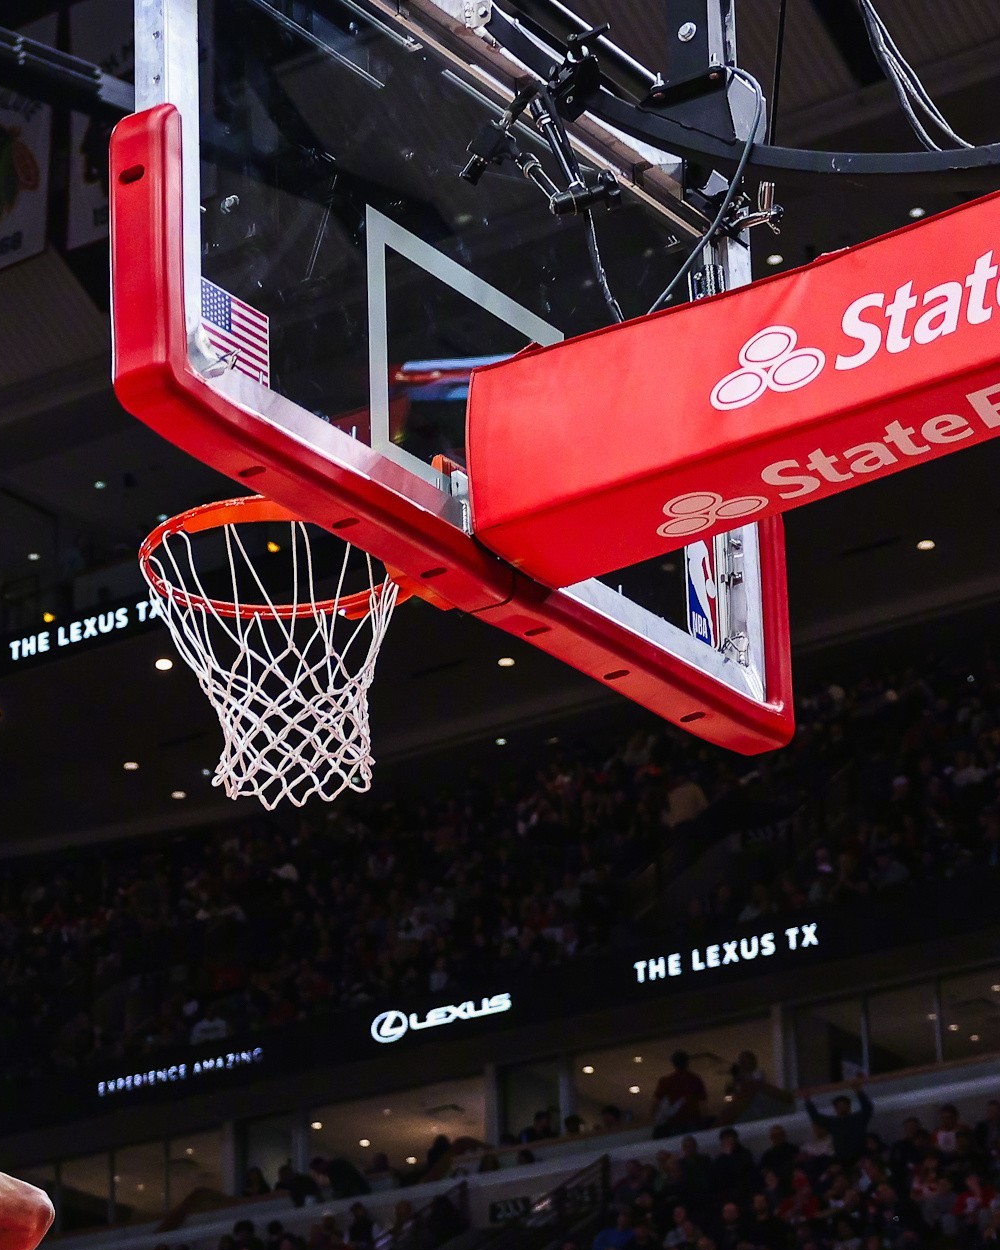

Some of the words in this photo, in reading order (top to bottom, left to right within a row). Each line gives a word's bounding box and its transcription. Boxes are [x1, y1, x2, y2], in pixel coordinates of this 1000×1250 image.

[834, 249, 1000, 371] Stat
[761, 412, 975, 500] State
[9, 631, 50, 661] THE
[57, 607, 129, 647] LEXUS
[691, 611, 709, 639] NBA
[633, 953, 682, 984] THE
[691, 932, 776, 971] LEXUS
[784, 922, 819, 950] TX
[409, 992, 512, 1031] LEXUS
